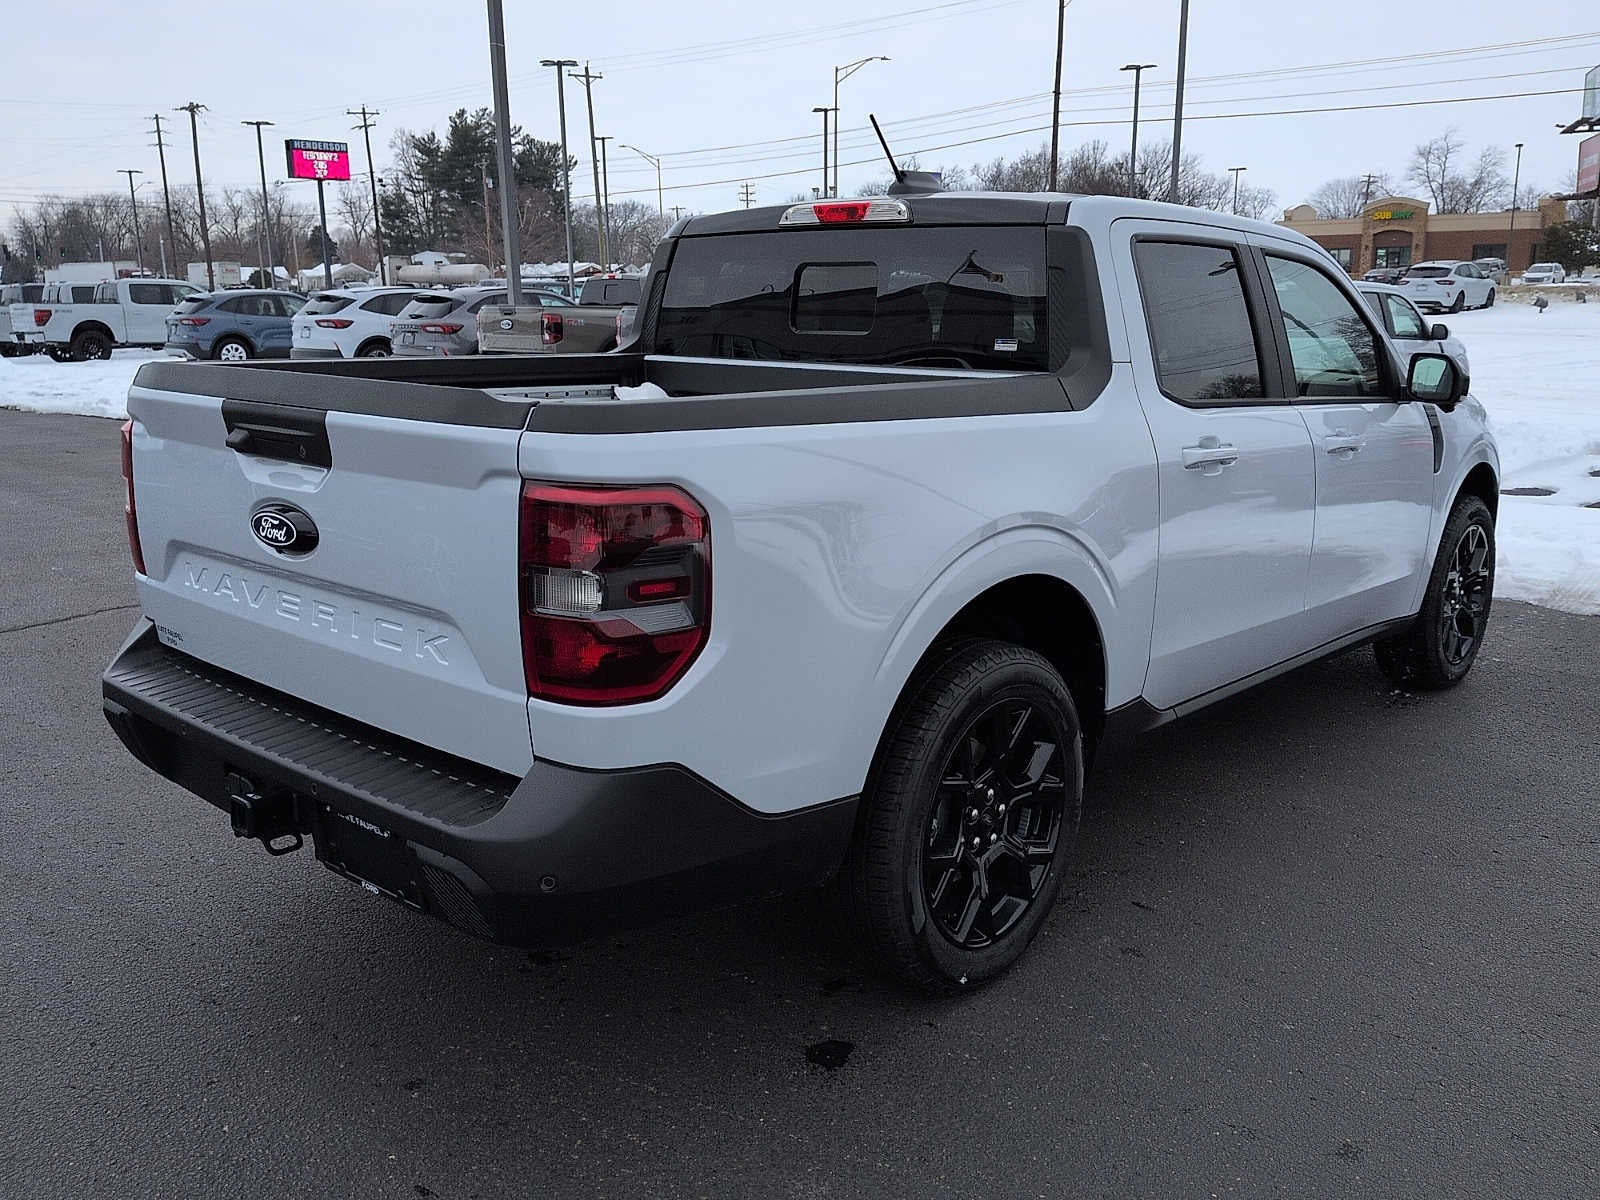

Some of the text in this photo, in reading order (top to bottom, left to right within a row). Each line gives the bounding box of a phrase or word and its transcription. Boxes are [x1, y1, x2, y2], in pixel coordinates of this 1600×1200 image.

[294, 140, 347, 152] HENDERSON
[1373, 210, 1414, 220] SUBWAY
[260, 516, 287, 542] Ford
[184, 561, 449, 666] MAVERICK
[361, 880, 379, 894] FORD
